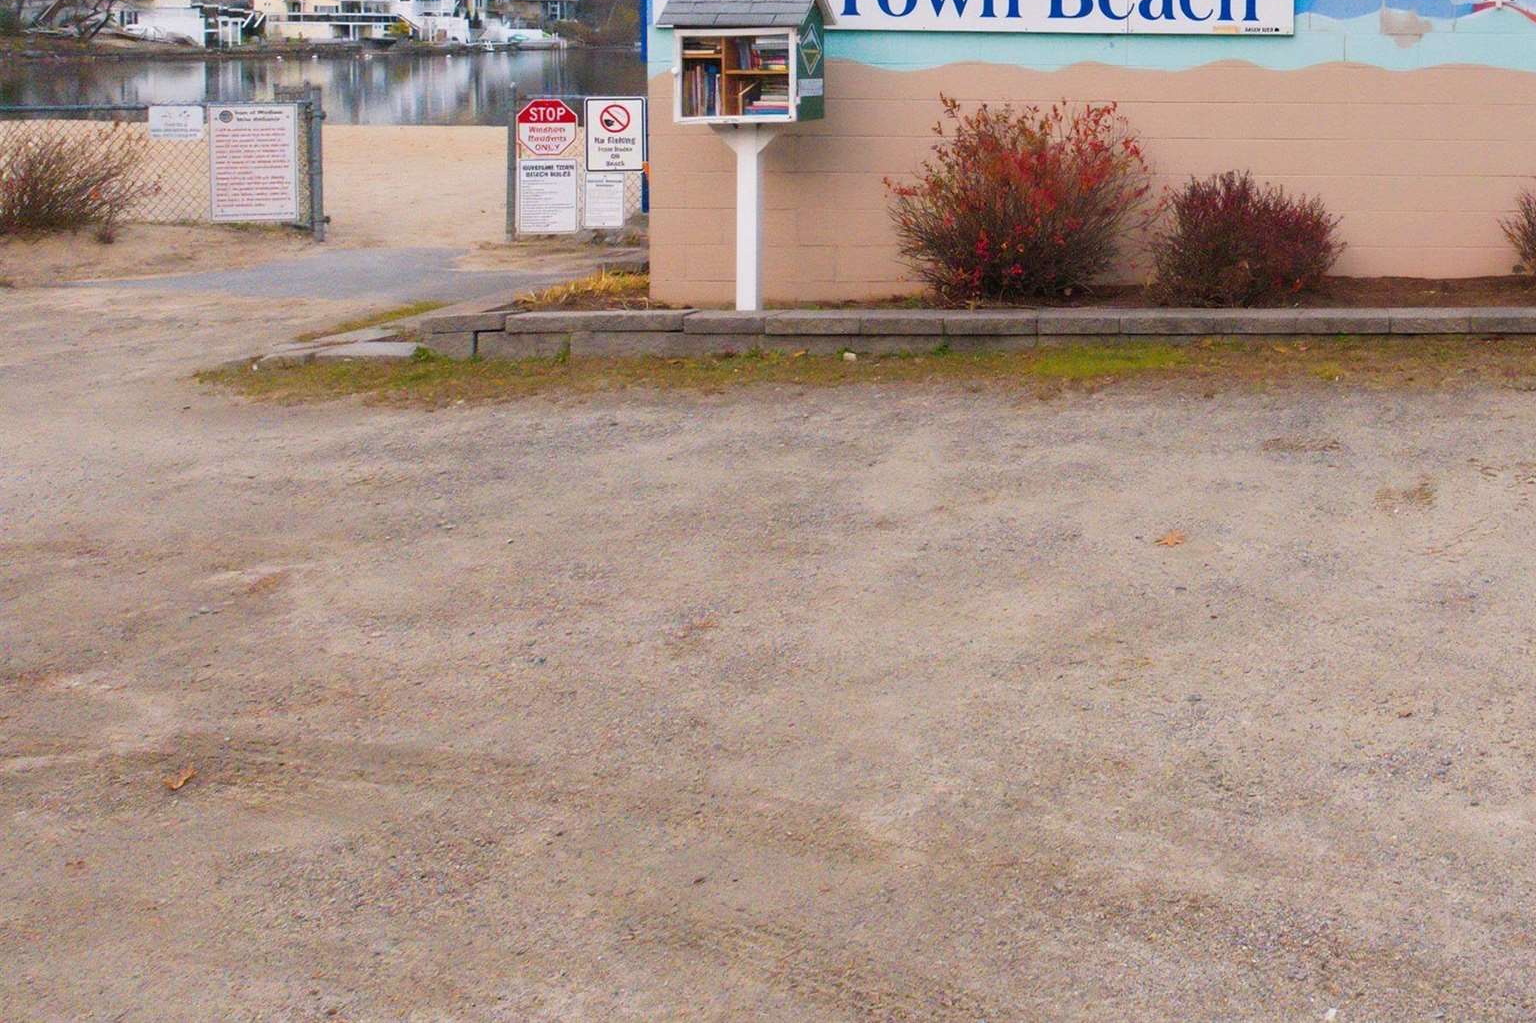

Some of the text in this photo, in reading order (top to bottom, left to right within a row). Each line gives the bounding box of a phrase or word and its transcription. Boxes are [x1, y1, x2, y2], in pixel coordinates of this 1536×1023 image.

[528, 106, 567, 122] STOP
[594, 136, 636, 146] No Fishing
[535, 143, 560, 152] ONLY
